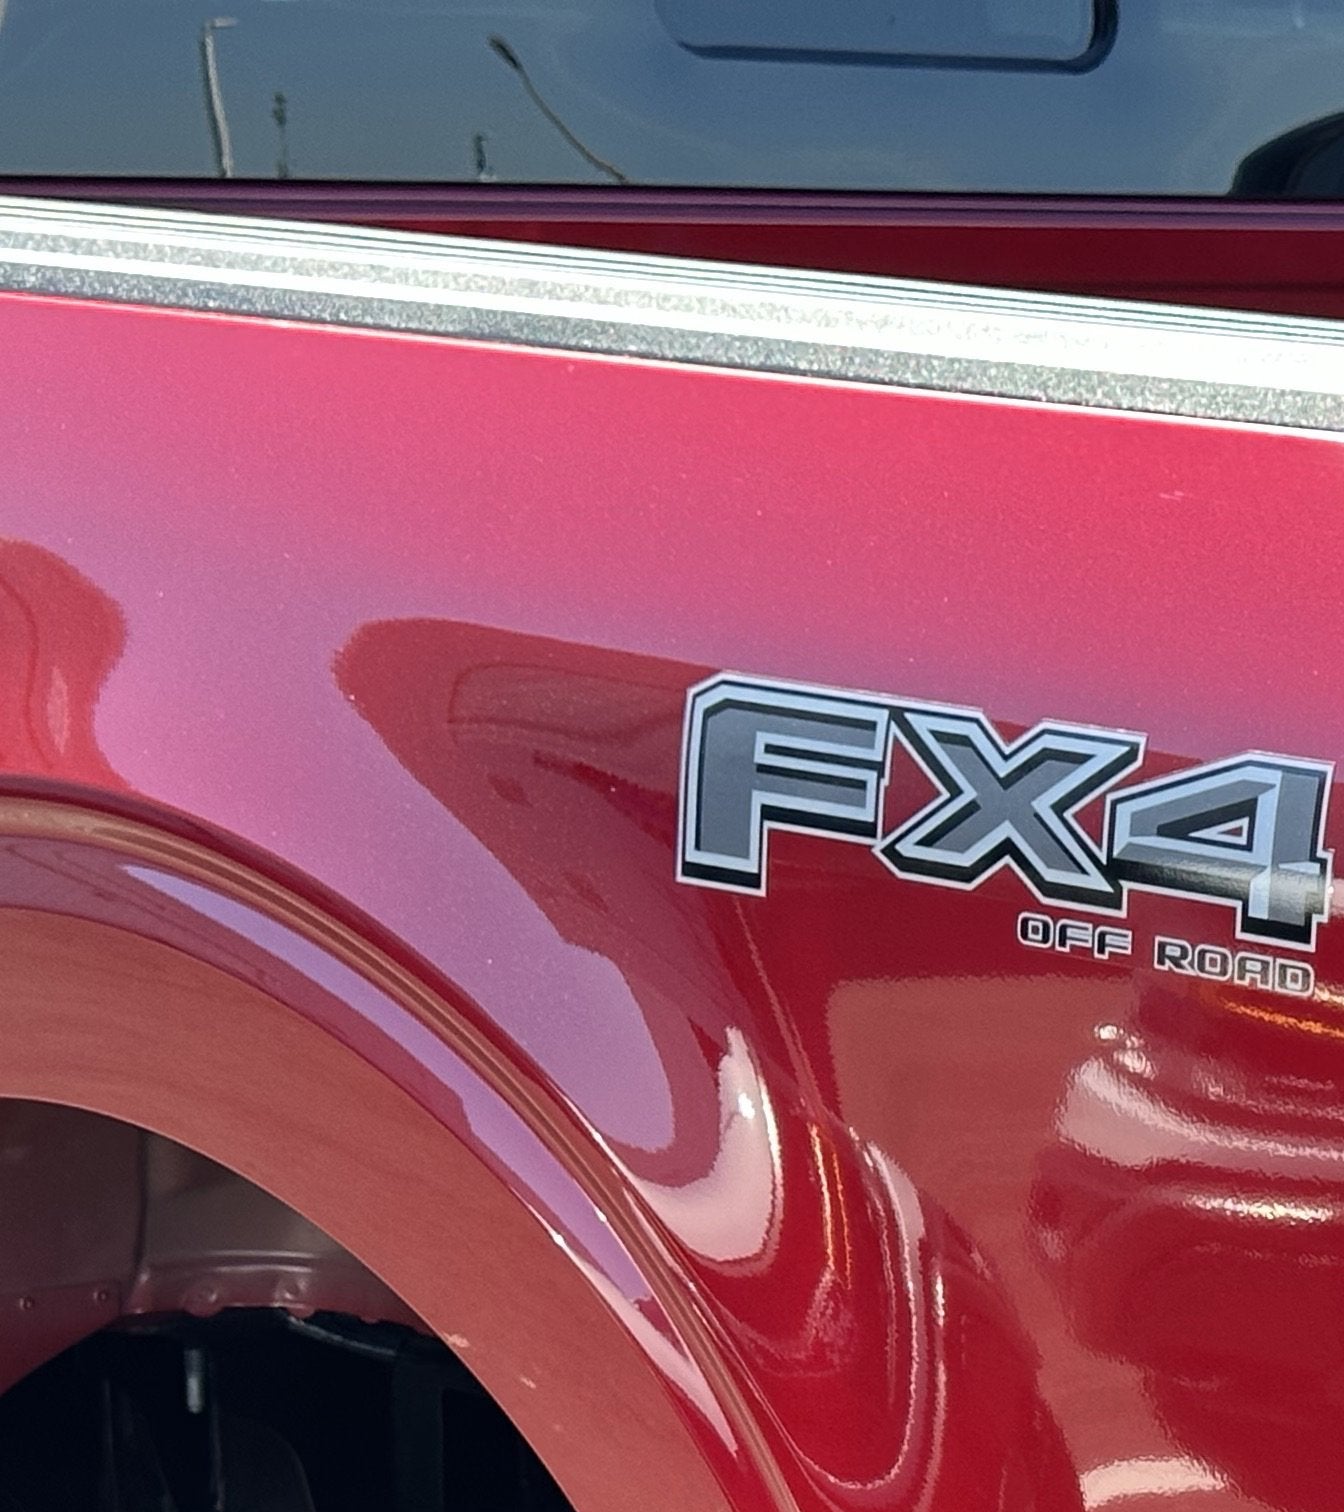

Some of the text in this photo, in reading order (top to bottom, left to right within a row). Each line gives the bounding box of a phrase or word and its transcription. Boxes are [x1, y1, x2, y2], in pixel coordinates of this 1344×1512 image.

[675, 670, 1336, 953] FX4
[1018, 912, 1317, 998] OFF ROAD
